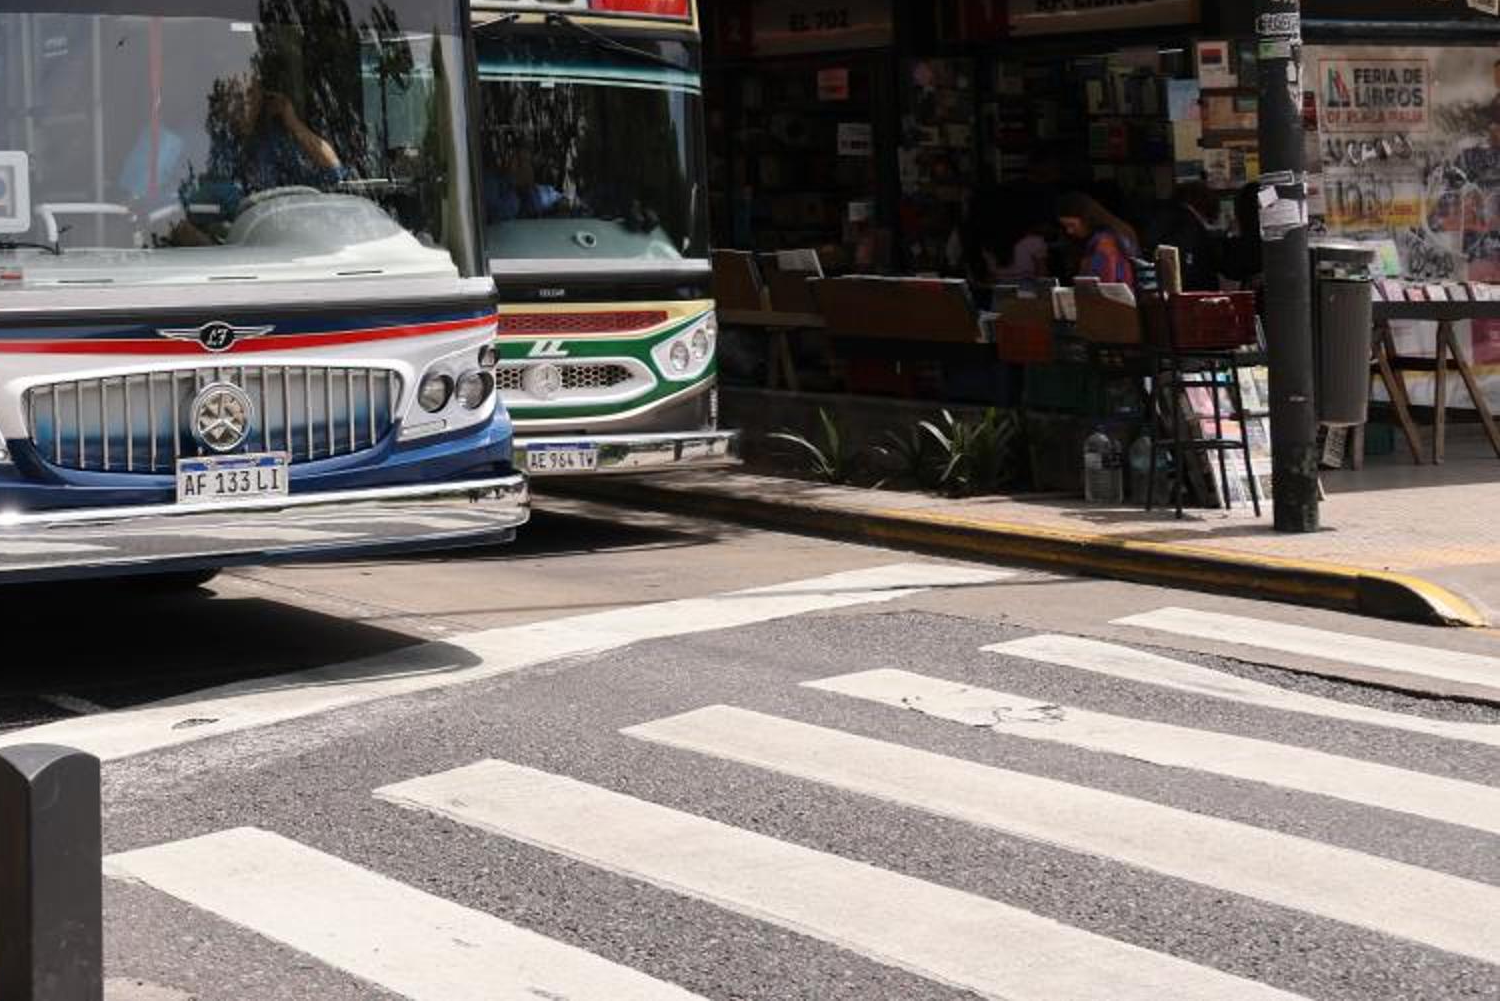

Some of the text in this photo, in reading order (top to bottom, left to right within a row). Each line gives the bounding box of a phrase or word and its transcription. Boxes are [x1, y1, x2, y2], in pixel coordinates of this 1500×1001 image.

[1353, 68, 1423, 84] FERIA DE
[1354, 87, 1423, 107] LIBROS
[184, 473, 207, 496] AF
[215, 471, 250, 494] 133
